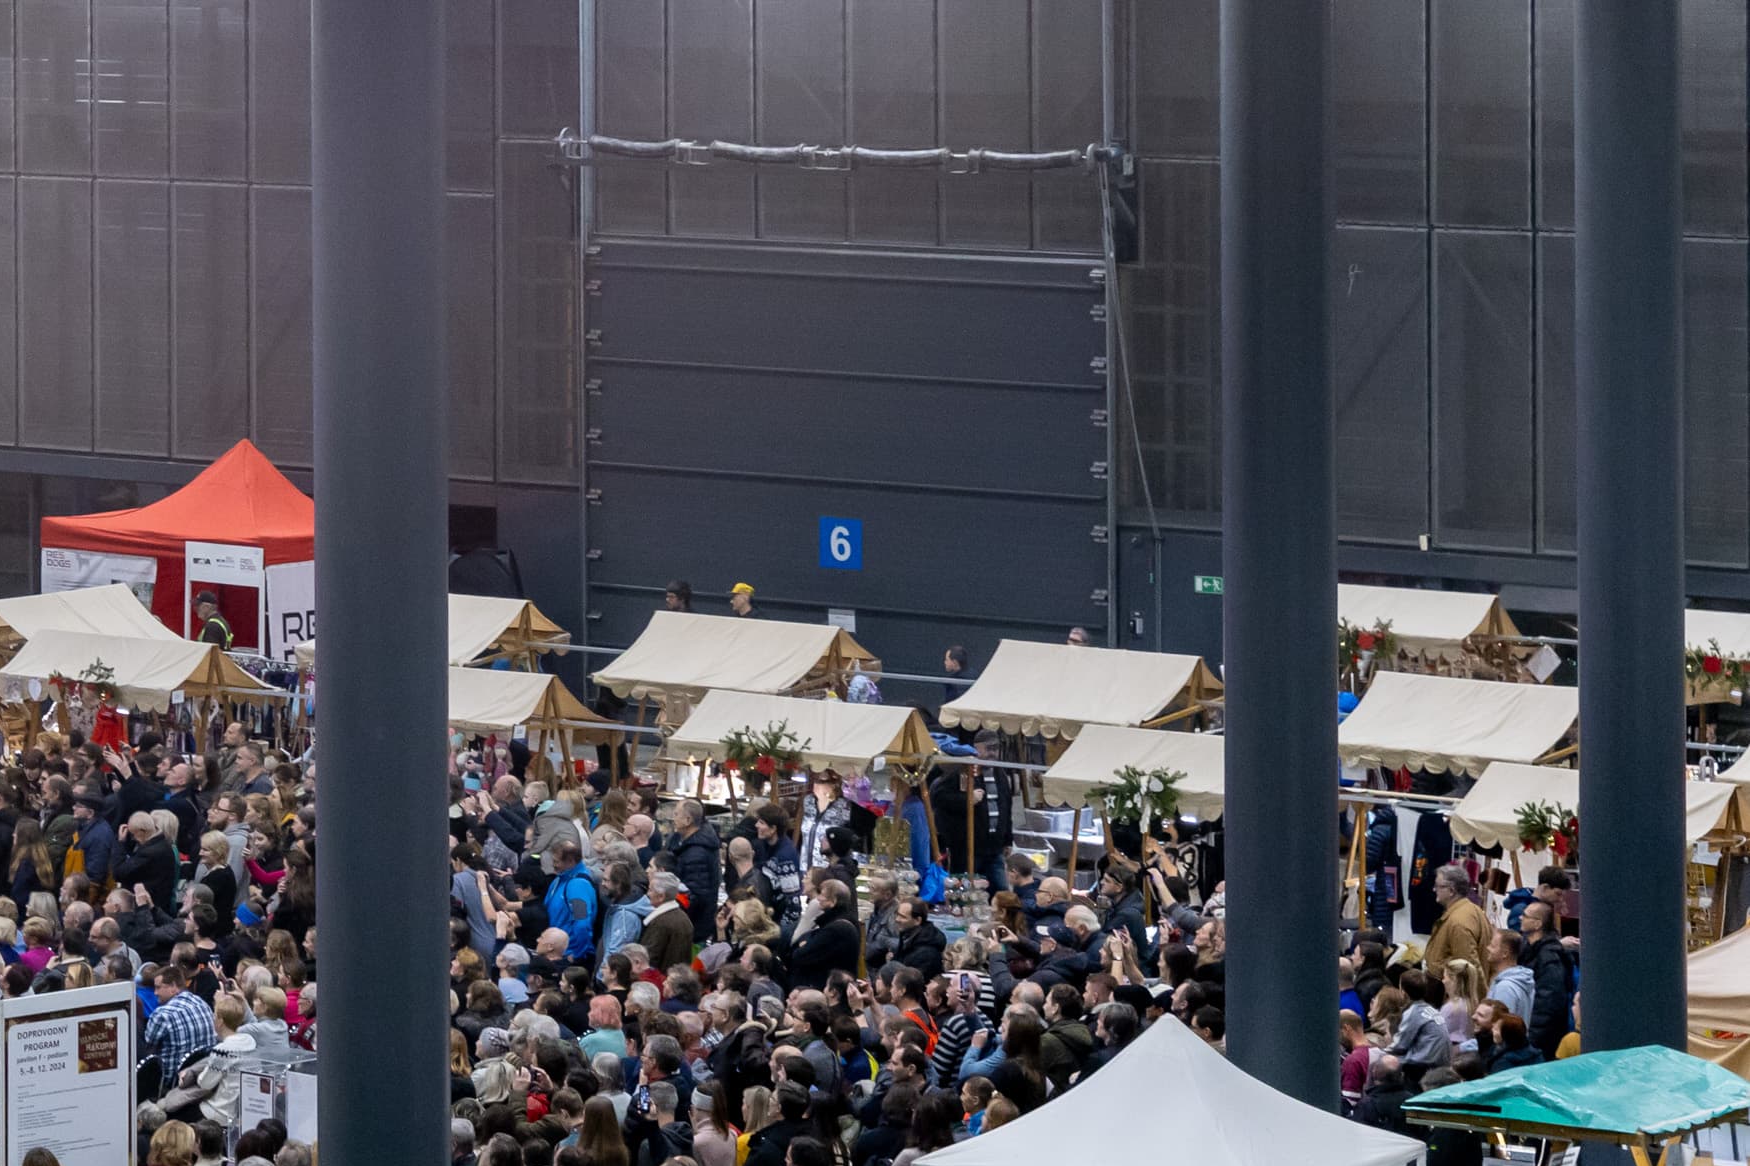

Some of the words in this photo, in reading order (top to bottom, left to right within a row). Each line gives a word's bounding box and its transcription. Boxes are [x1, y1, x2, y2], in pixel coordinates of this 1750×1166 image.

[830, 526, 851, 561] 6
[282, 610, 315, 643] RE
[23, 1040, 60, 1052] PROGRAM
[49, 1062, 66, 1072] 2024
